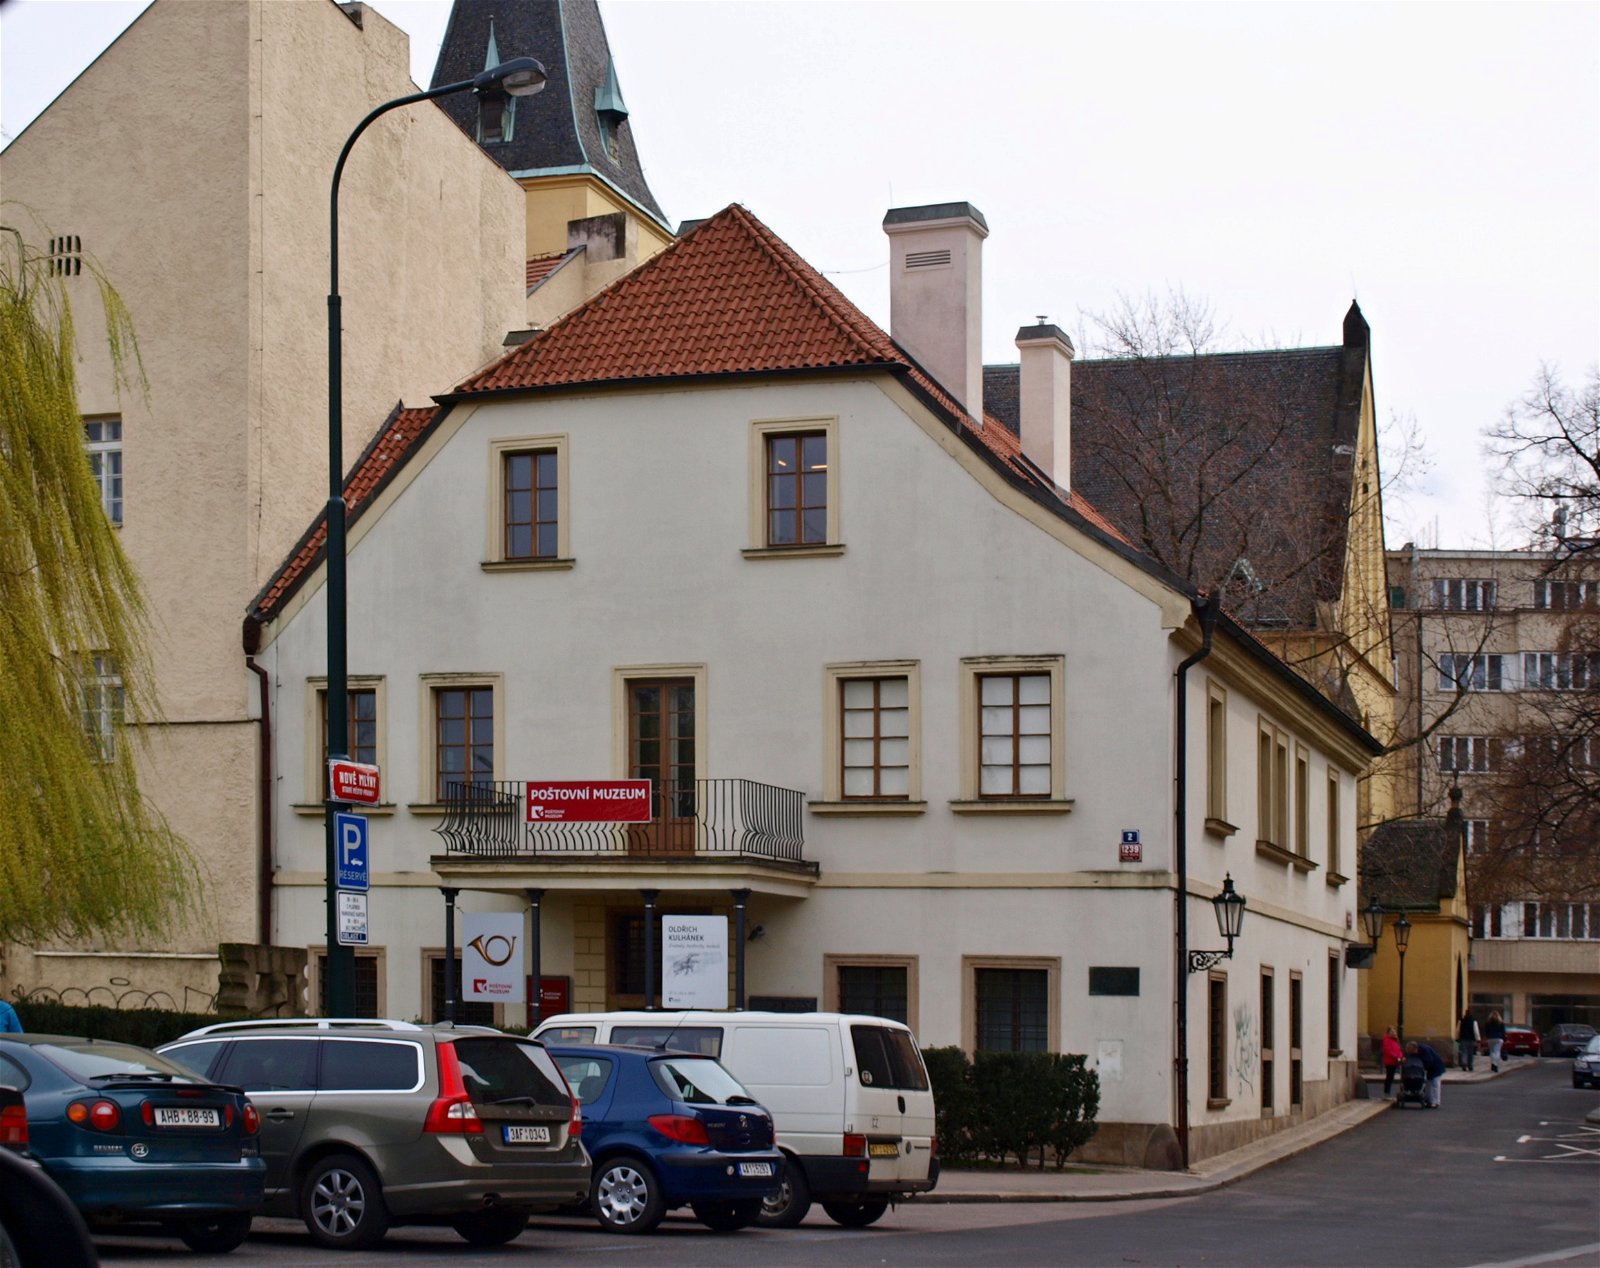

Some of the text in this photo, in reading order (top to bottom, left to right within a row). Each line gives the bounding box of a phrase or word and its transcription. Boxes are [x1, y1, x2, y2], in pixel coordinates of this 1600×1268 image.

[339, 771, 376, 788] NOVÉ MLÝNY
[531, 786, 646, 800] POŠTOVNÍ MUZEUM
[1127, 832, 1133, 841] 2
[343, 823, 361, 865] P
[1121, 845, 1140, 854] 1239
[668, 925, 698, 933] OLDŘICH
[161, 1109, 215, 1124] AHB 88-99
[510, 1128, 547, 1141] 3AF 0343
[134, 1145, 146, 1154] CZ
